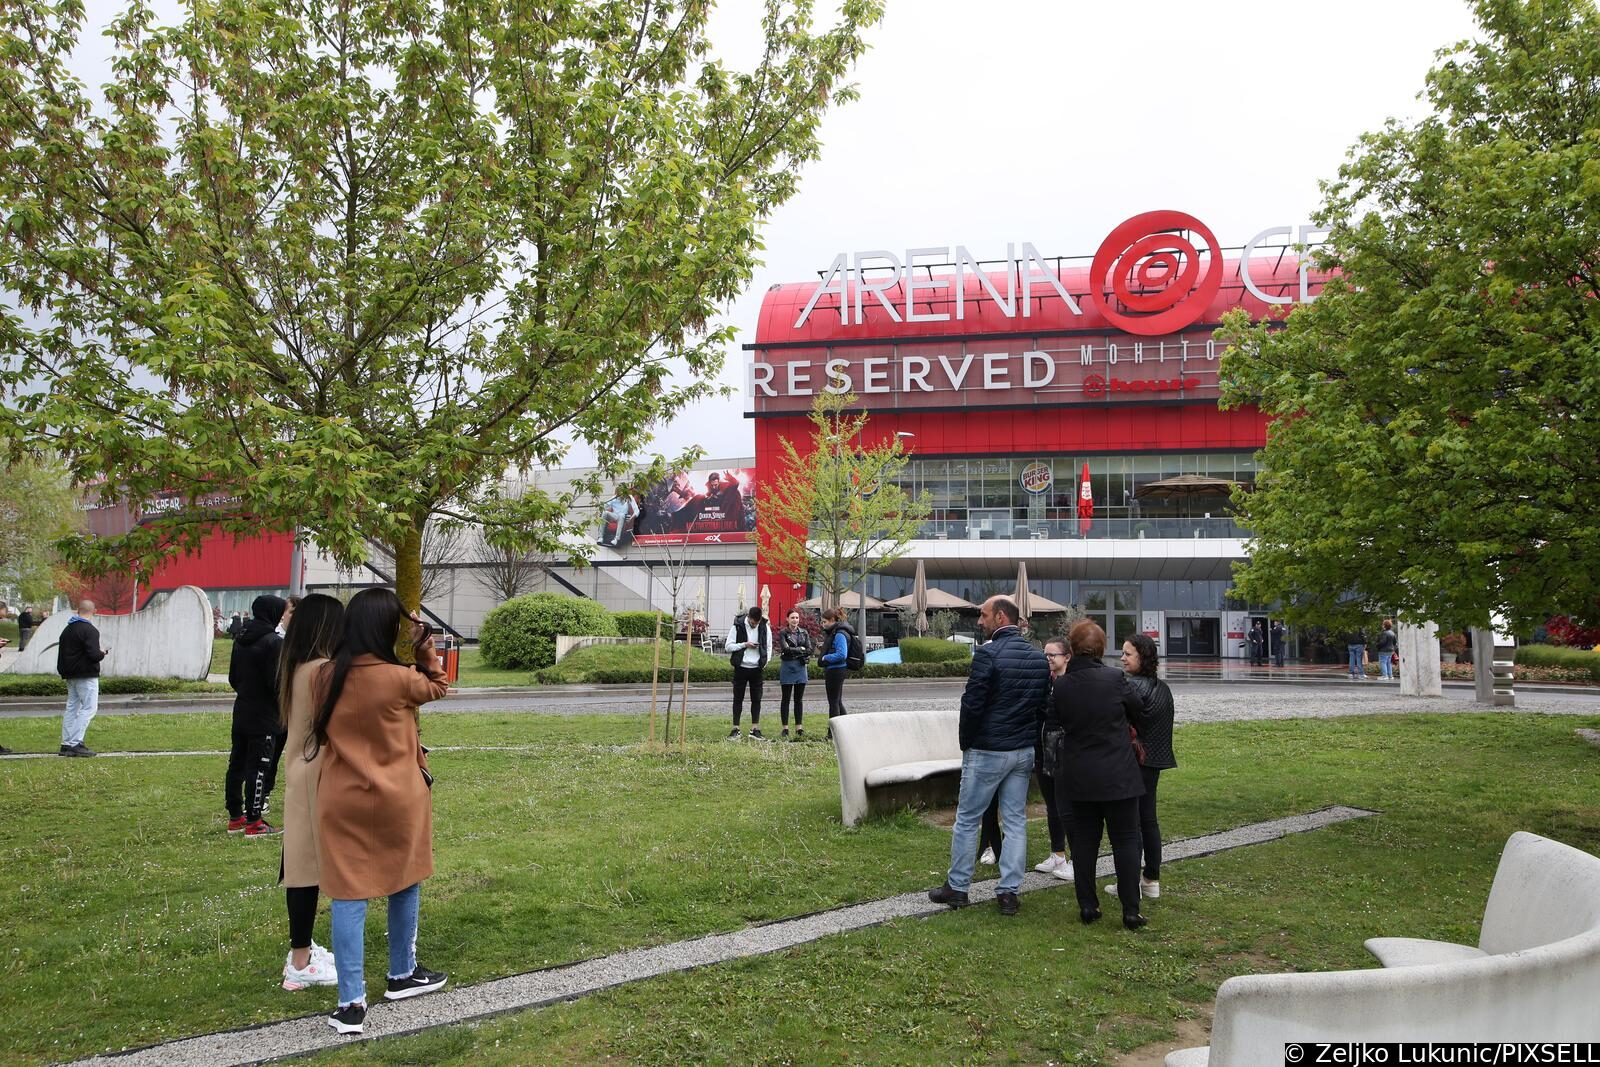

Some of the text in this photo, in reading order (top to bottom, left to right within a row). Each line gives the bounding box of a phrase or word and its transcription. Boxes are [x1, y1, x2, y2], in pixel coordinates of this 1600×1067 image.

[793, 225, 1336, 328] ARENA CE
[1080, 339, 1215, 366] MOHITO
[748, 351, 1056, 397] RESERVED
[1024, 472, 1050, 488] KING
